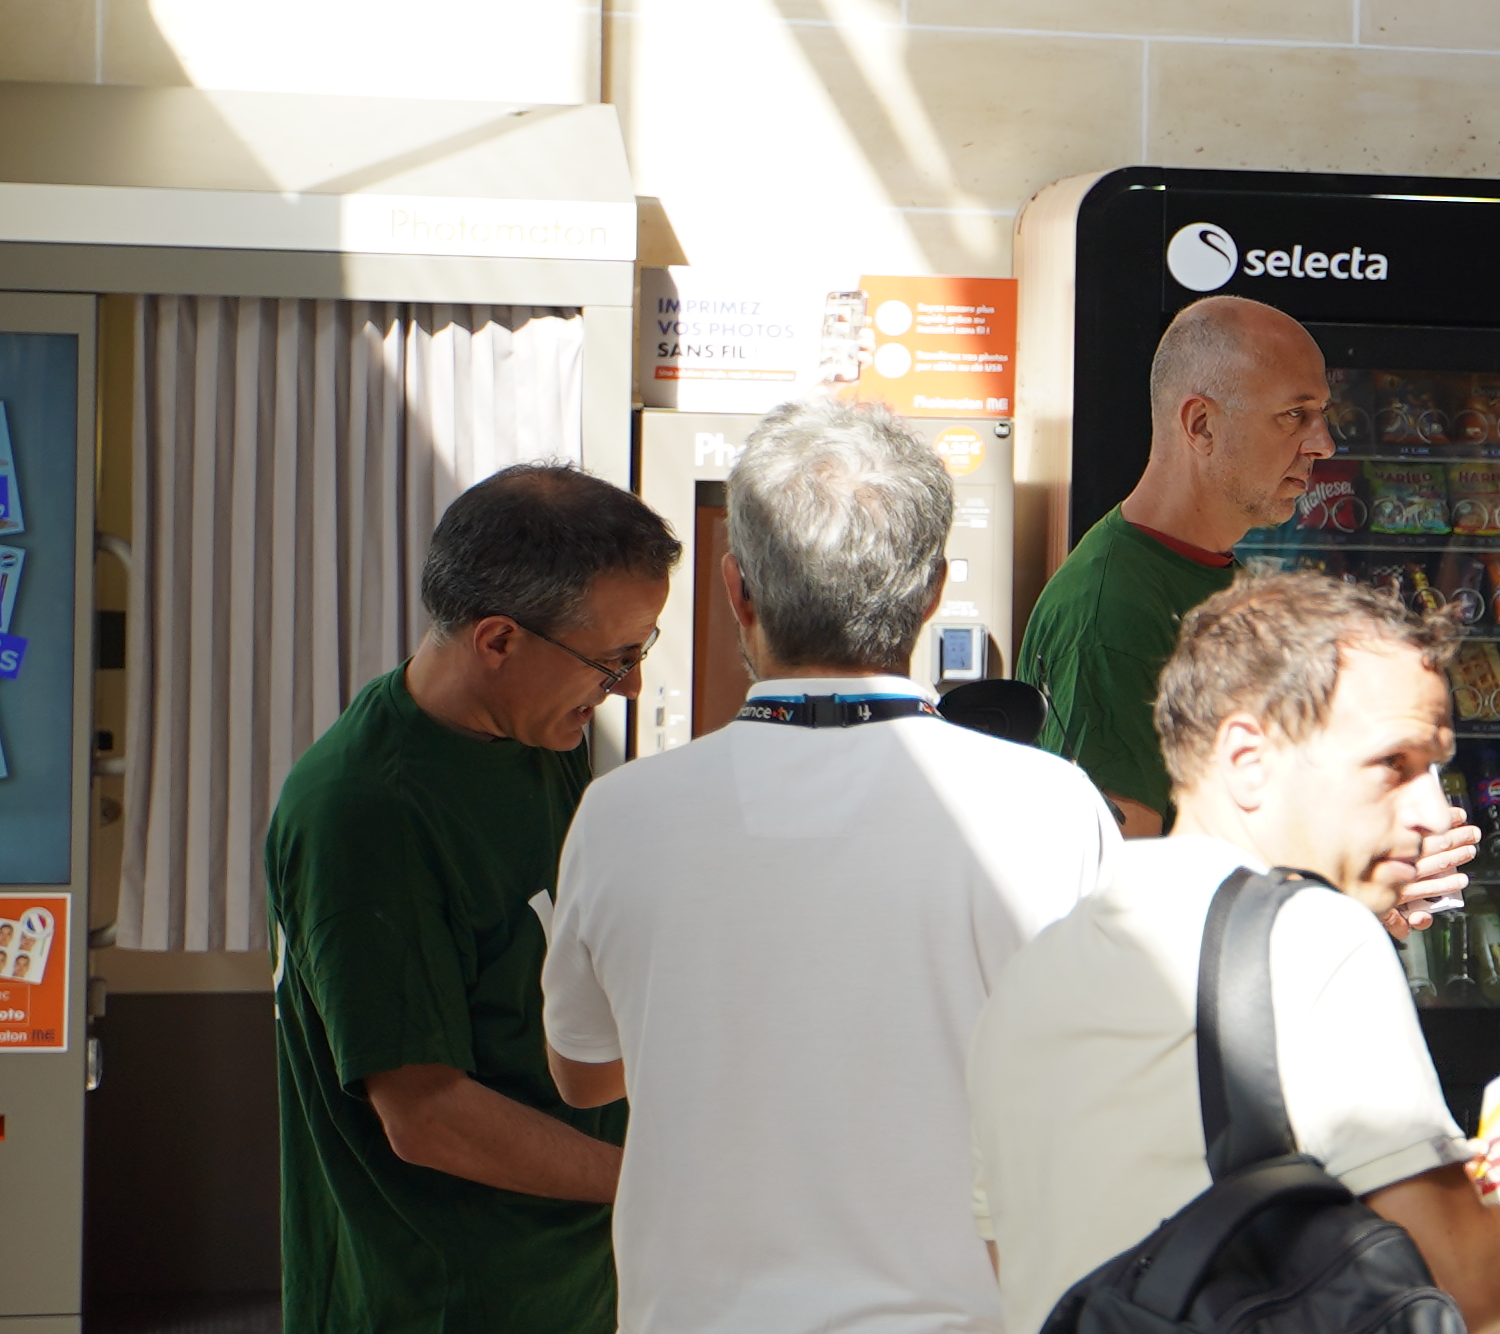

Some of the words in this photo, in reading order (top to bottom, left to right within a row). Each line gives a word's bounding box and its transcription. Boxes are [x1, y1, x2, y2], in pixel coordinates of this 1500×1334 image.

[391, 208, 606, 245] Photomaton
[1243, 243, 1389, 282] selecta
[657, 297, 761, 316] IMPRIMEZ
[657, 319, 702, 337] VOS
[709, 322, 794, 339] PHOTOS
[657, 341, 715, 359] SANS
[721, 343, 747, 359] FIL
